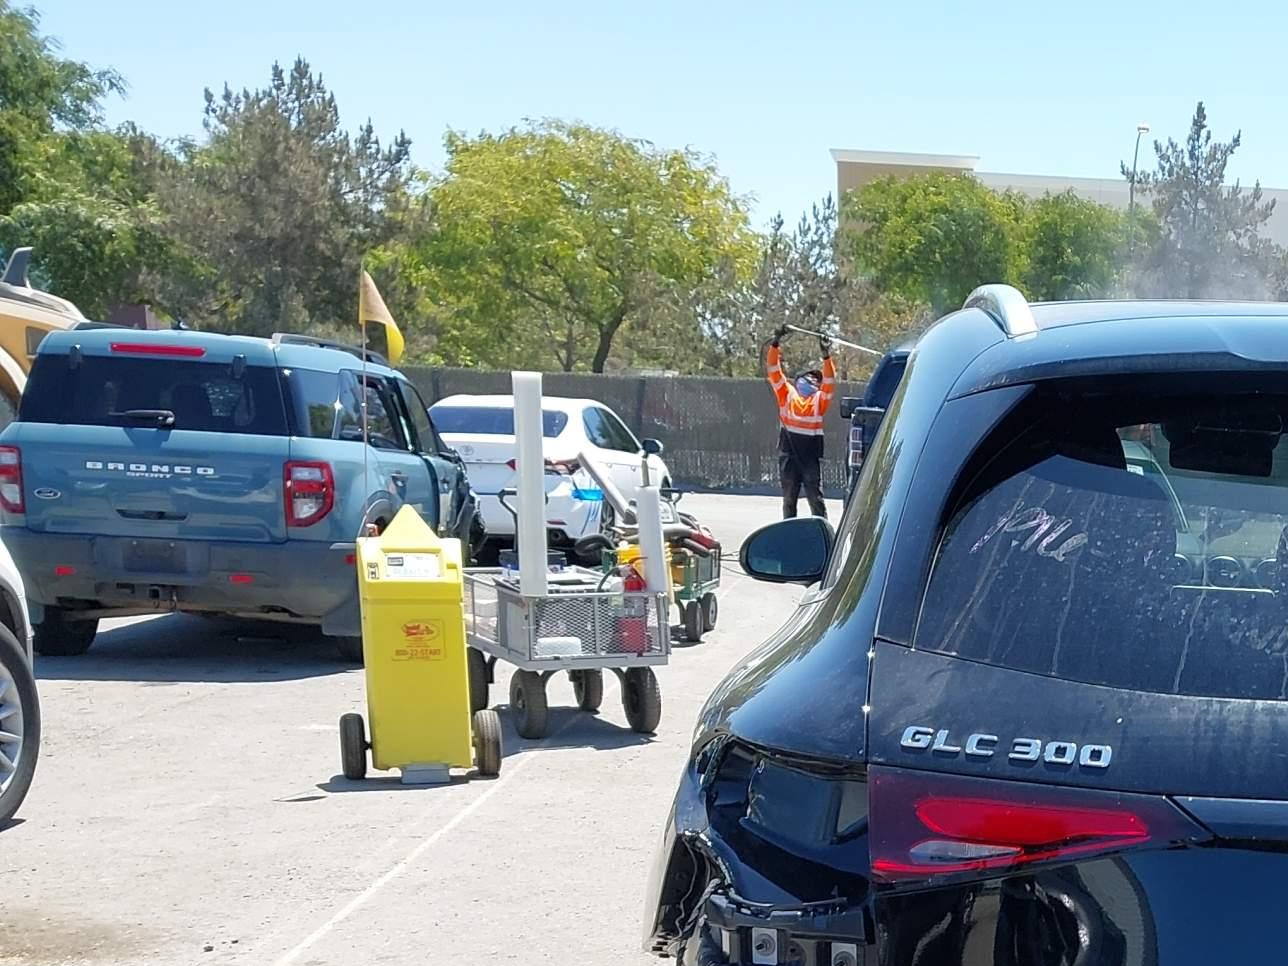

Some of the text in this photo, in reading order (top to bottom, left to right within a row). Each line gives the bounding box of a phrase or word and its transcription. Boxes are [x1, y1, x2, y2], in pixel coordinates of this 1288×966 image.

[86, 461, 215, 475] BRONCO
[126, 471, 173, 479] SPORT
[900, 725, 1113, 768] GLC 300
